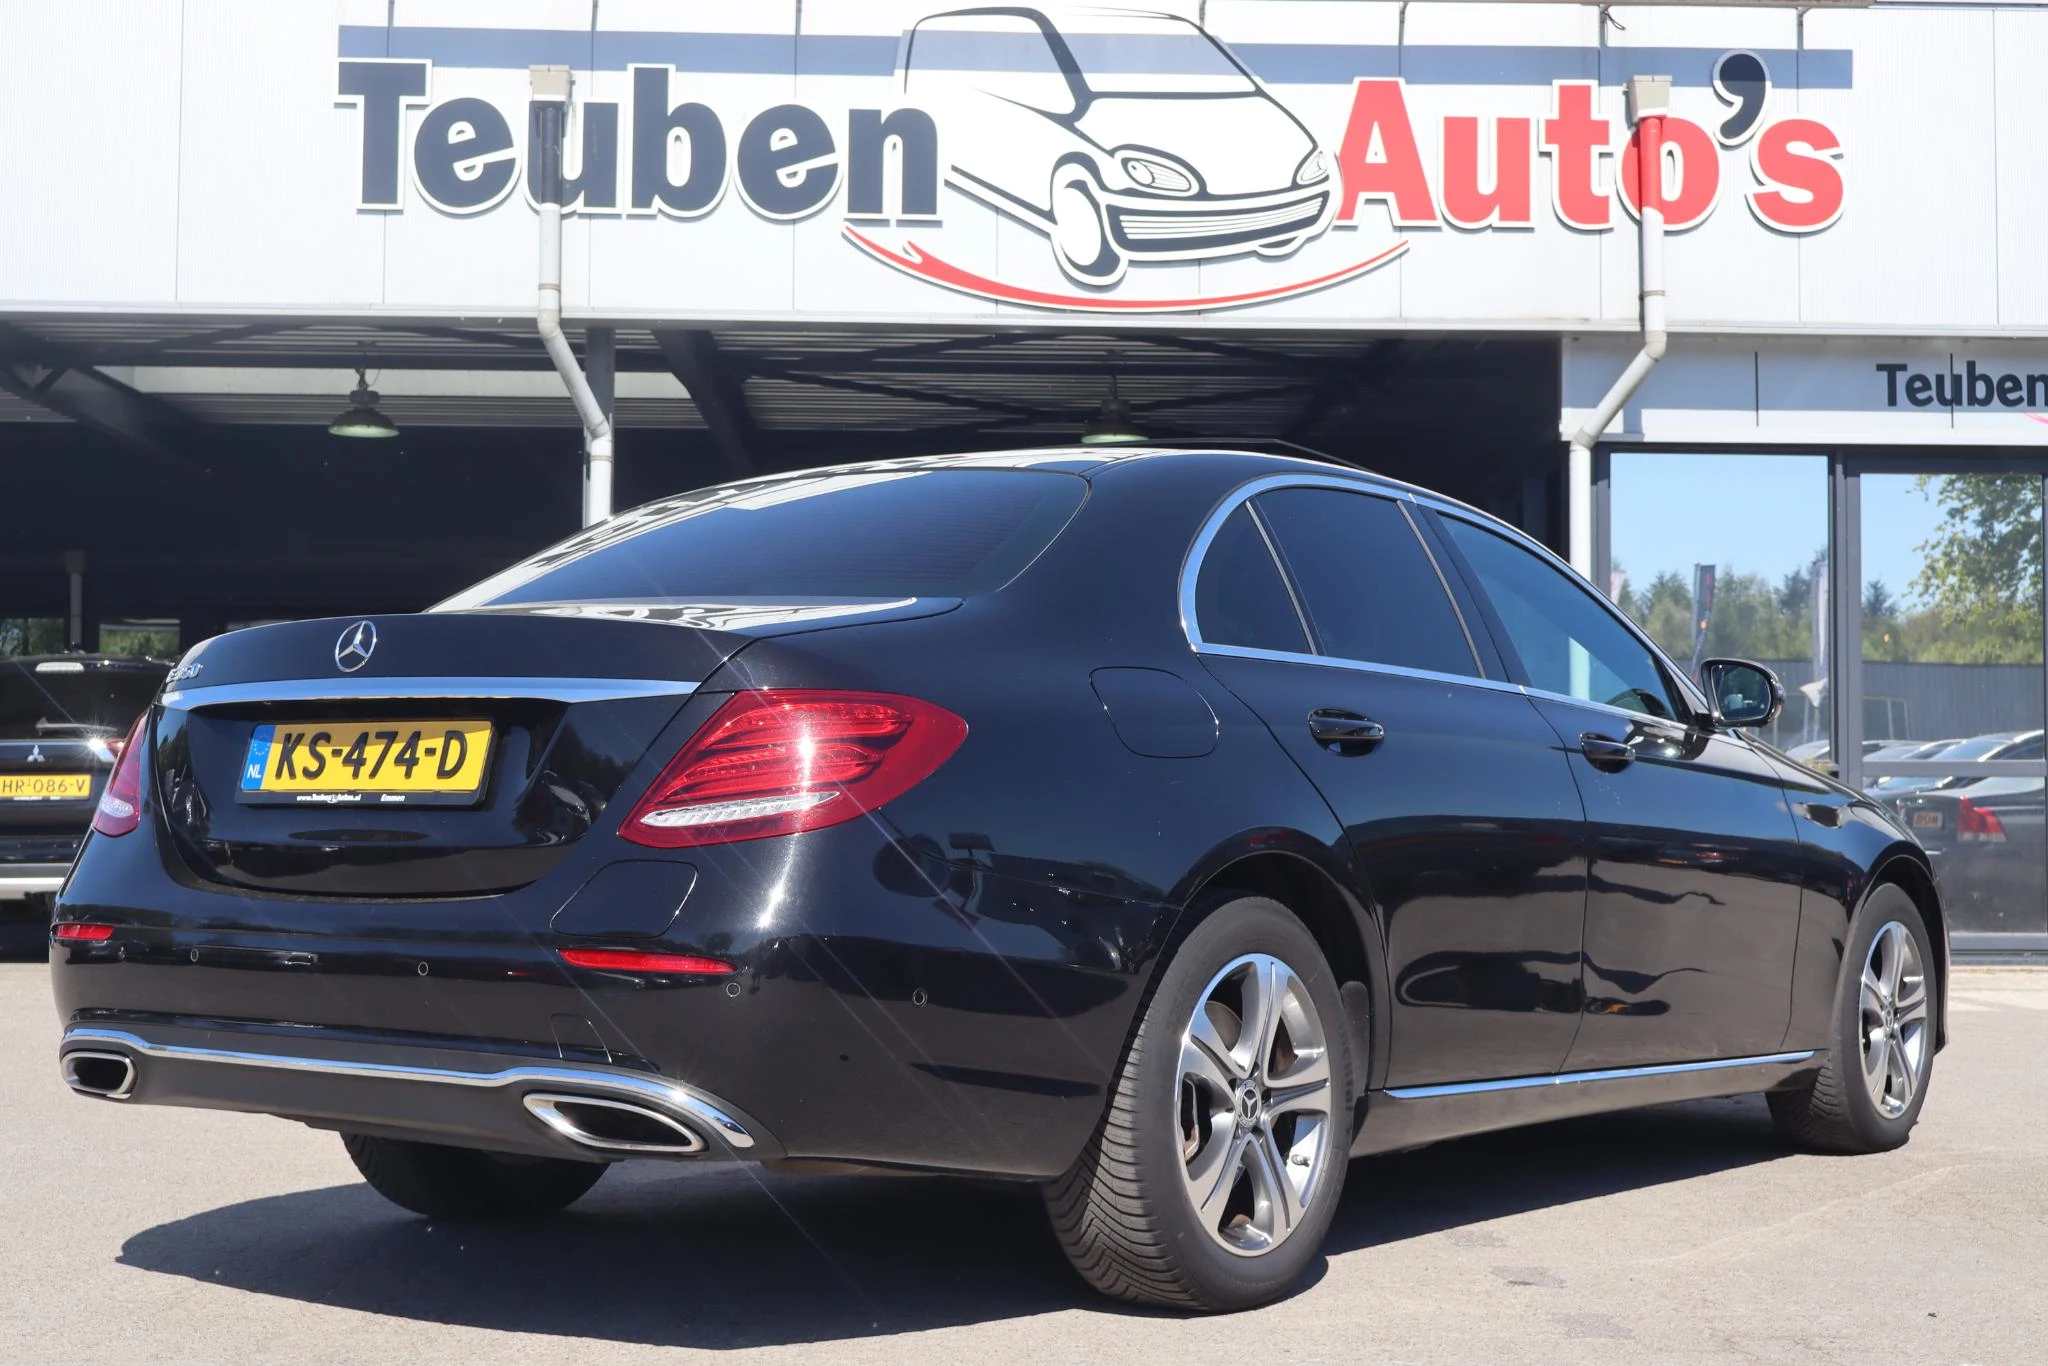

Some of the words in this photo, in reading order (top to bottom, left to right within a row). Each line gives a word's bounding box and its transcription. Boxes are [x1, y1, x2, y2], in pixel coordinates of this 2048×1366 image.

[337, 60, 939, 217] Teuben
[1336, 50, 1845, 228] Auto's
[1875, 359, 2048, 408] Teuben
[246, 763, 262, 779] NL
[274, 730, 468, 780] KS-474-D
[380, 793, 406, 802] Emmen
